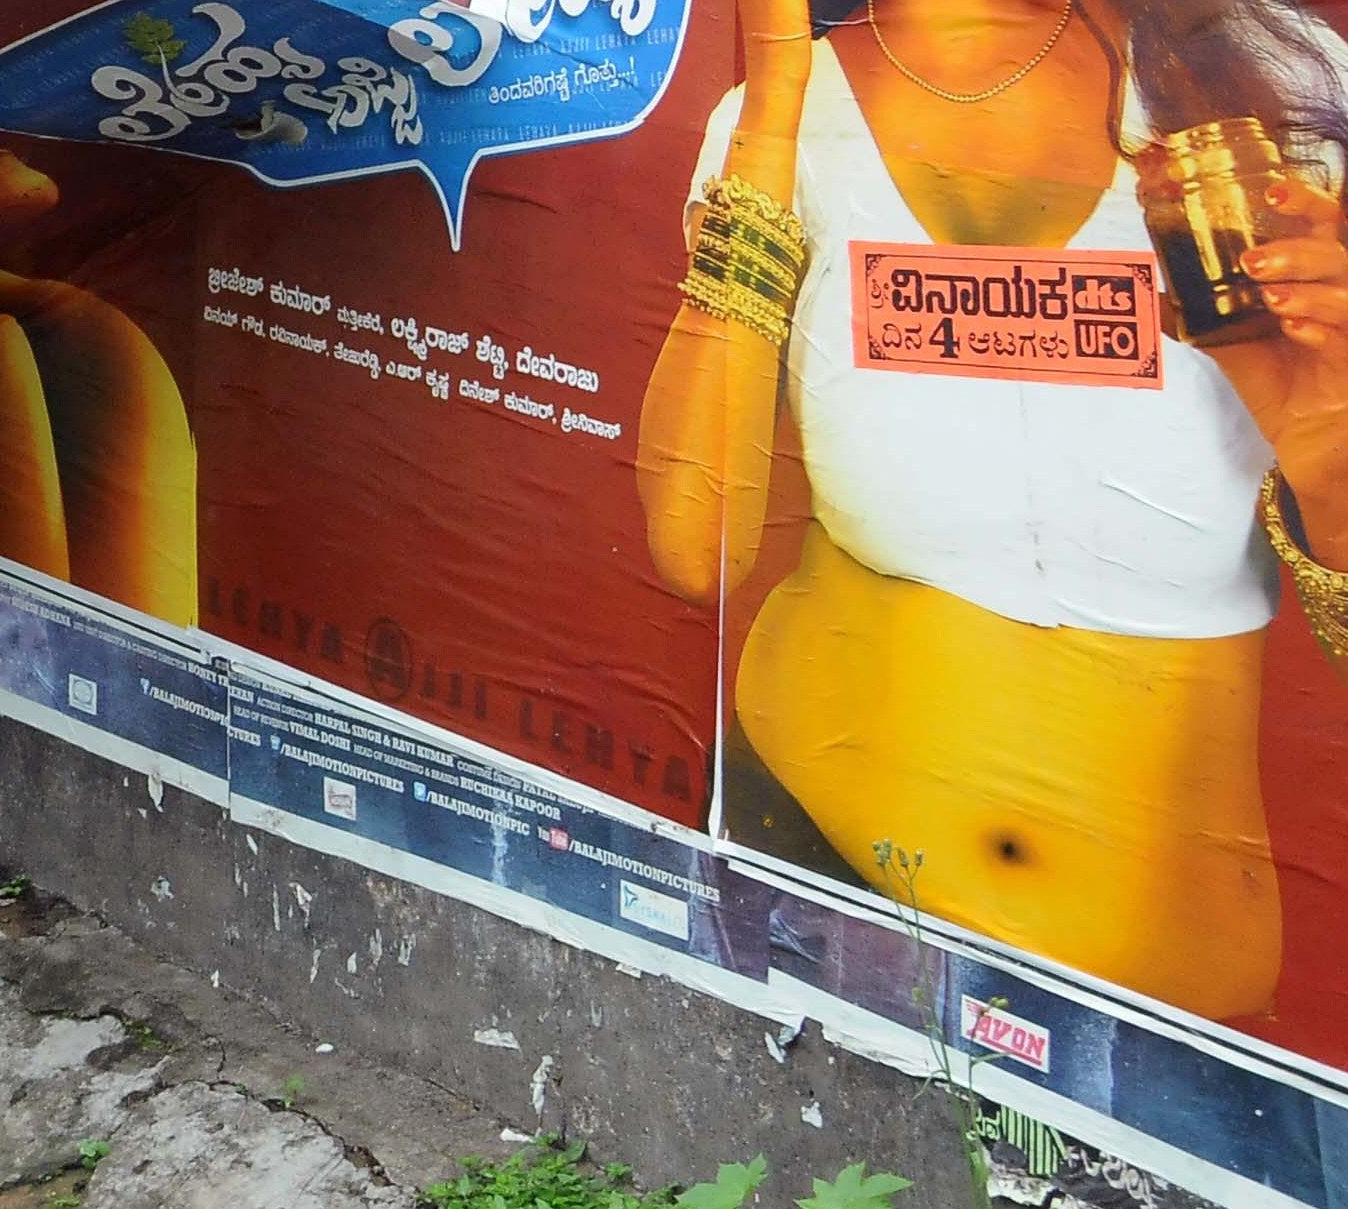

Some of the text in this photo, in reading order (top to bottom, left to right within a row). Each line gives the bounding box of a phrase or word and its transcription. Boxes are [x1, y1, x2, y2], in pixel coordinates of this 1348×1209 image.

[890, 265, 1068, 321] ವಿನಾಯಕ
[1074, 277, 1134, 311] dts
[270, 280, 332, 316] ಕುಮಾರ್
[515, 345, 600, 393] ದೇವರಾಜು
[881, 317, 1136, 360] ದಿನ 4 ಆಟಗಳು UFO
[314, 712, 351, 734] HARPAL
[352, 723, 383, 744] SINGH
[392, 737, 416, 754] RAVI
[416, 745, 455, 768] KUMAR
[289, 720, 320, 742] VIMAL
[321, 730, 352, 752] DOSHI
[514, 793, 562, 822] KAPOOR
[967, 1013, 1047, 1061] AVON
